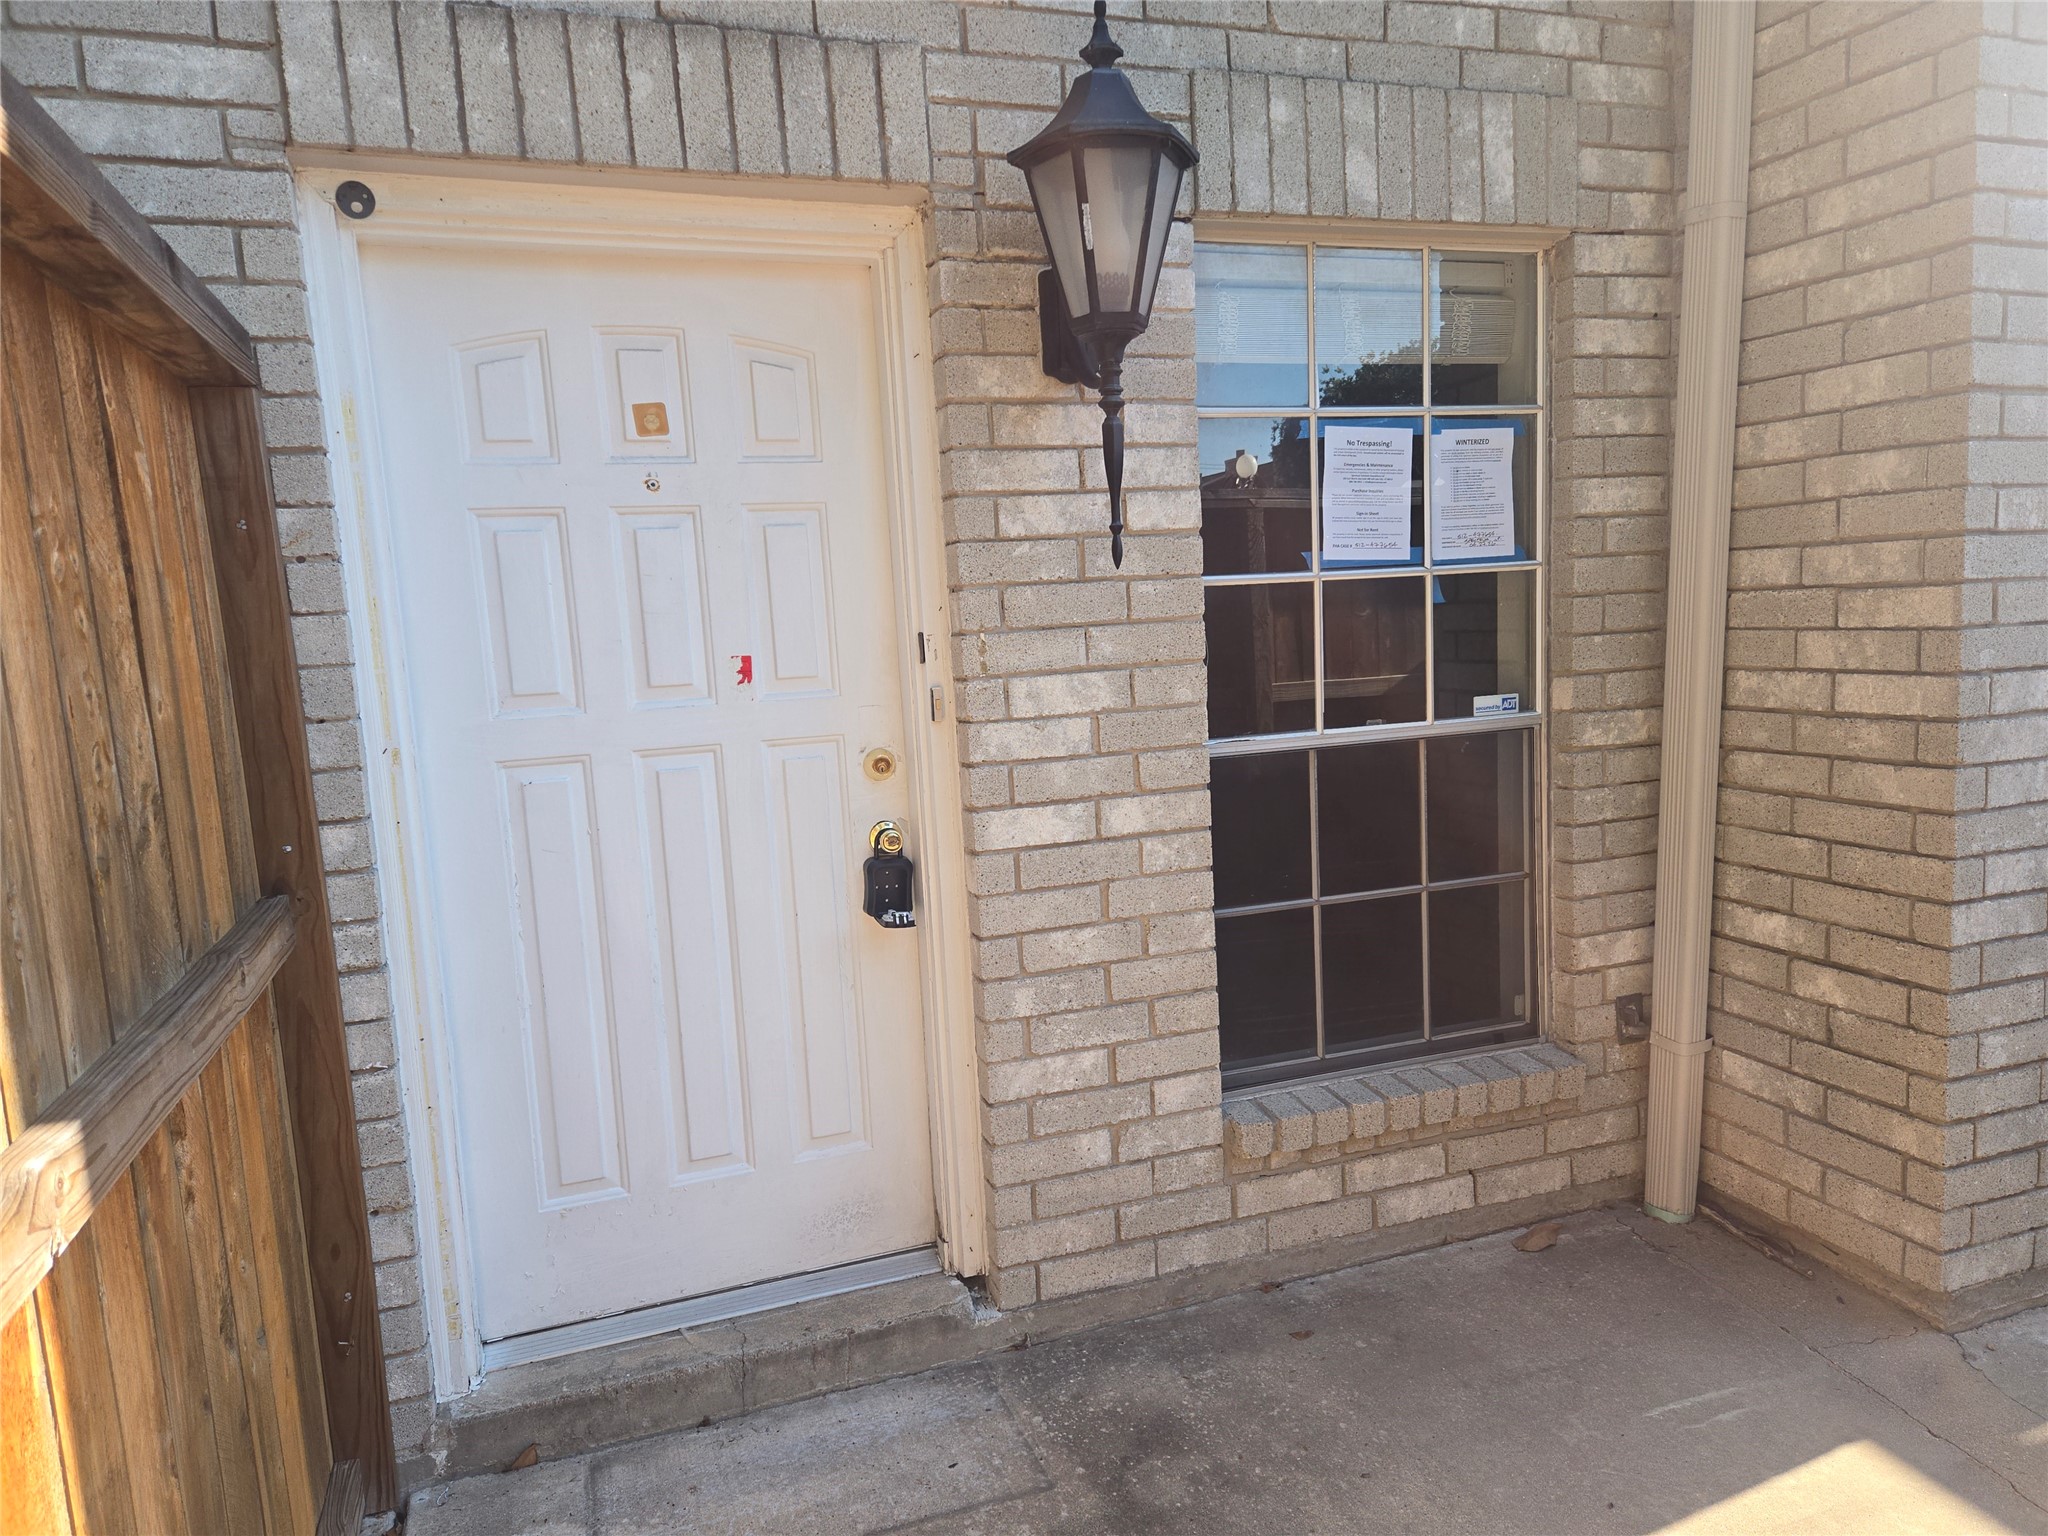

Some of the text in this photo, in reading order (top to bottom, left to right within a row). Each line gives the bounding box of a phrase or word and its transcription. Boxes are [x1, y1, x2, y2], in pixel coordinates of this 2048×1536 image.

[1356, 440, 1393, 448] Trespassing!
[1455, 438, 1490, 446] WINTERIZED
[1502, 699, 1517, 709] ADT
